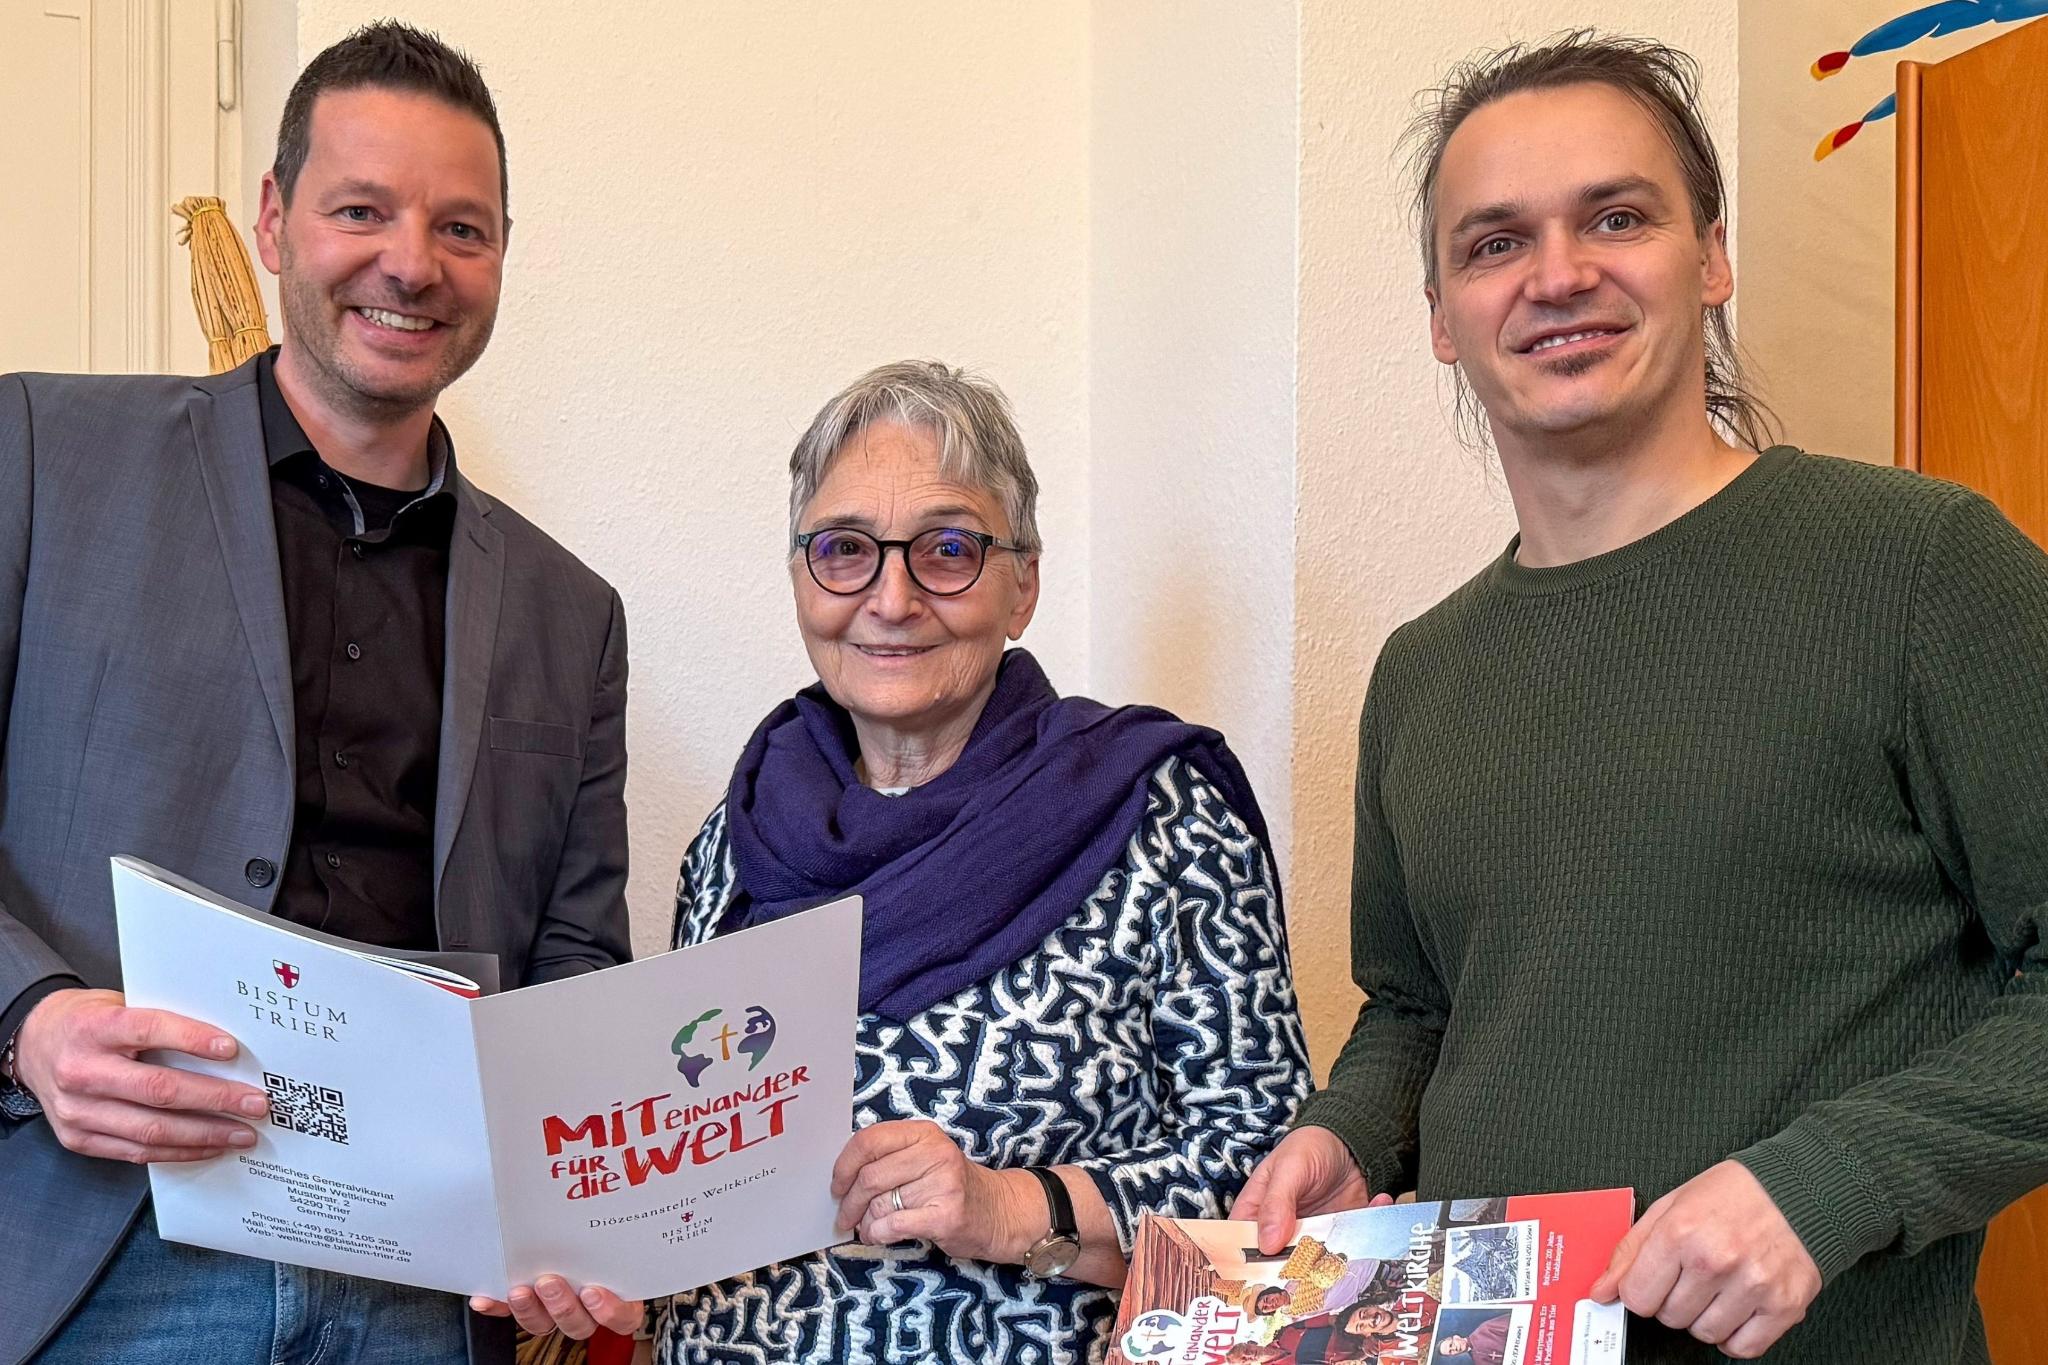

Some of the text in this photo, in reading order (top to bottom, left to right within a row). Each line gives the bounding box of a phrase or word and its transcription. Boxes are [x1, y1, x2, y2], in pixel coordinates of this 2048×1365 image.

[236, 980, 348, 1025] BISTUM
[249, 1003, 340, 1043] TRIER
[239, 1155, 395, 1201] Bischöfliches Generalvikariat
[249, 1167, 387, 1207] Diözesanstelle Weltkirche
[566, 1170, 621, 1200] die
[287, 1186, 340, 1205] Mustorstr.
[289, 1195, 351, 1215] 54290 Trier
[589, 1166, 777, 1229] Diözesanstelle Weltkirche
[251, 1211, 290, 1226] Phone:
[292, 1221, 322, 1233] (+49)
[324, 1227, 344, 1237] 651
[348, 1231, 376, 1243] 7105
[296, 1206, 346, 1223] Germany
[661, 1216, 713, 1239] BISTUM
[241, 1217, 412, 1257] Mail: weltkirche@bistum-trier.de
[246, 1226, 411, 1263] Web: weltkirche.bistum-trier.de
[667, 1227, 709, 1245] TRIER
